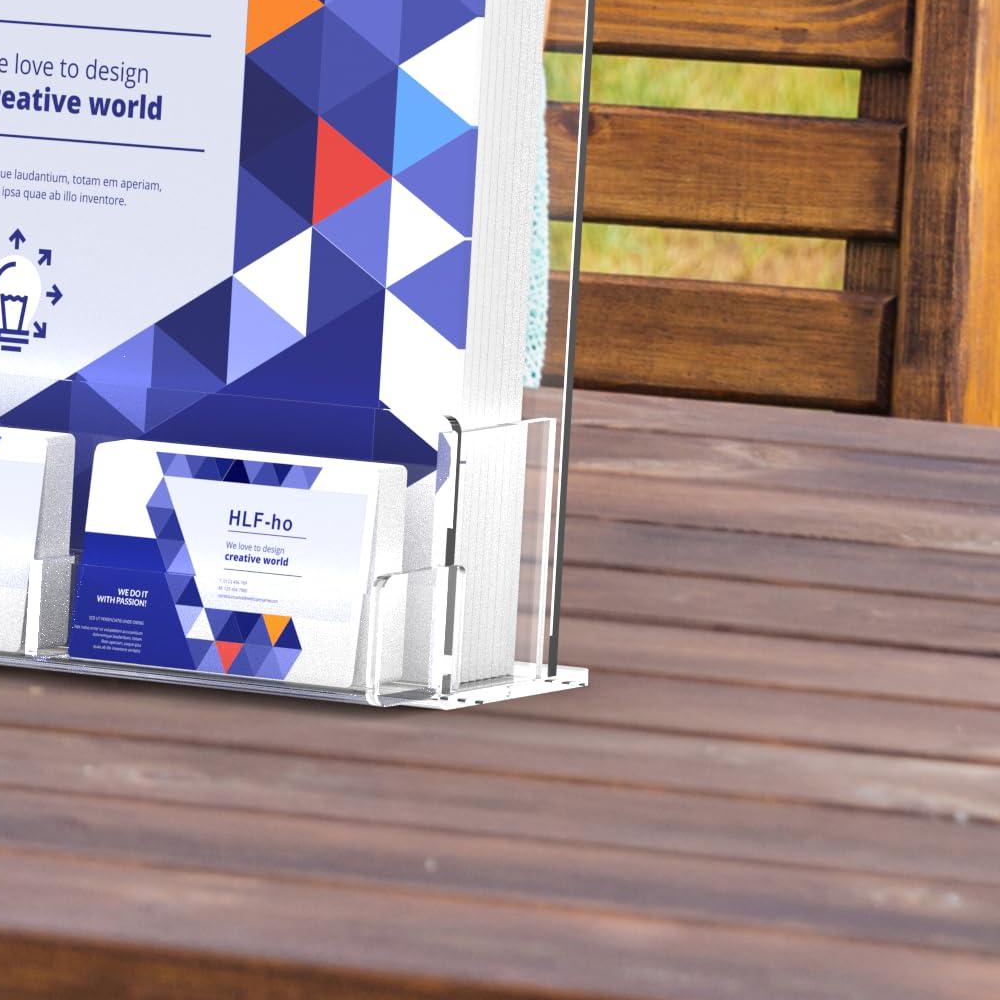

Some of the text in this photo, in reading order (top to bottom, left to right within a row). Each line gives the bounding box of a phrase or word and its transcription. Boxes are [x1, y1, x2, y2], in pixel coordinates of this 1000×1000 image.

[14, 52, 54, 77] love
[59, 57, 79, 79] to
[85, 58, 149, 89] design
[88, 93, 163, 121] world
[14, 168, 70, 185] laudantium,
[72, 175, 101, 187] totam
[102, 177, 118, 188] em
[120, 177, 162, 192] aperiam,
[1, 186, 21, 200] ipsa
[23, 189, 47, 202] quae
[49, 189, 61, 201] ab
[63, 190, 78, 202] illo
[79, 192, 127, 207] inventore.
[228, 509, 293, 532] HLF-ho
[225, 541, 285, 555] We love to design
[224, 553, 289, 567] creative world
[97, 595, 147, 607] WITH PASSION!
[118, 588, 129, 596] WE
[130, 589, 141, 597] DO
